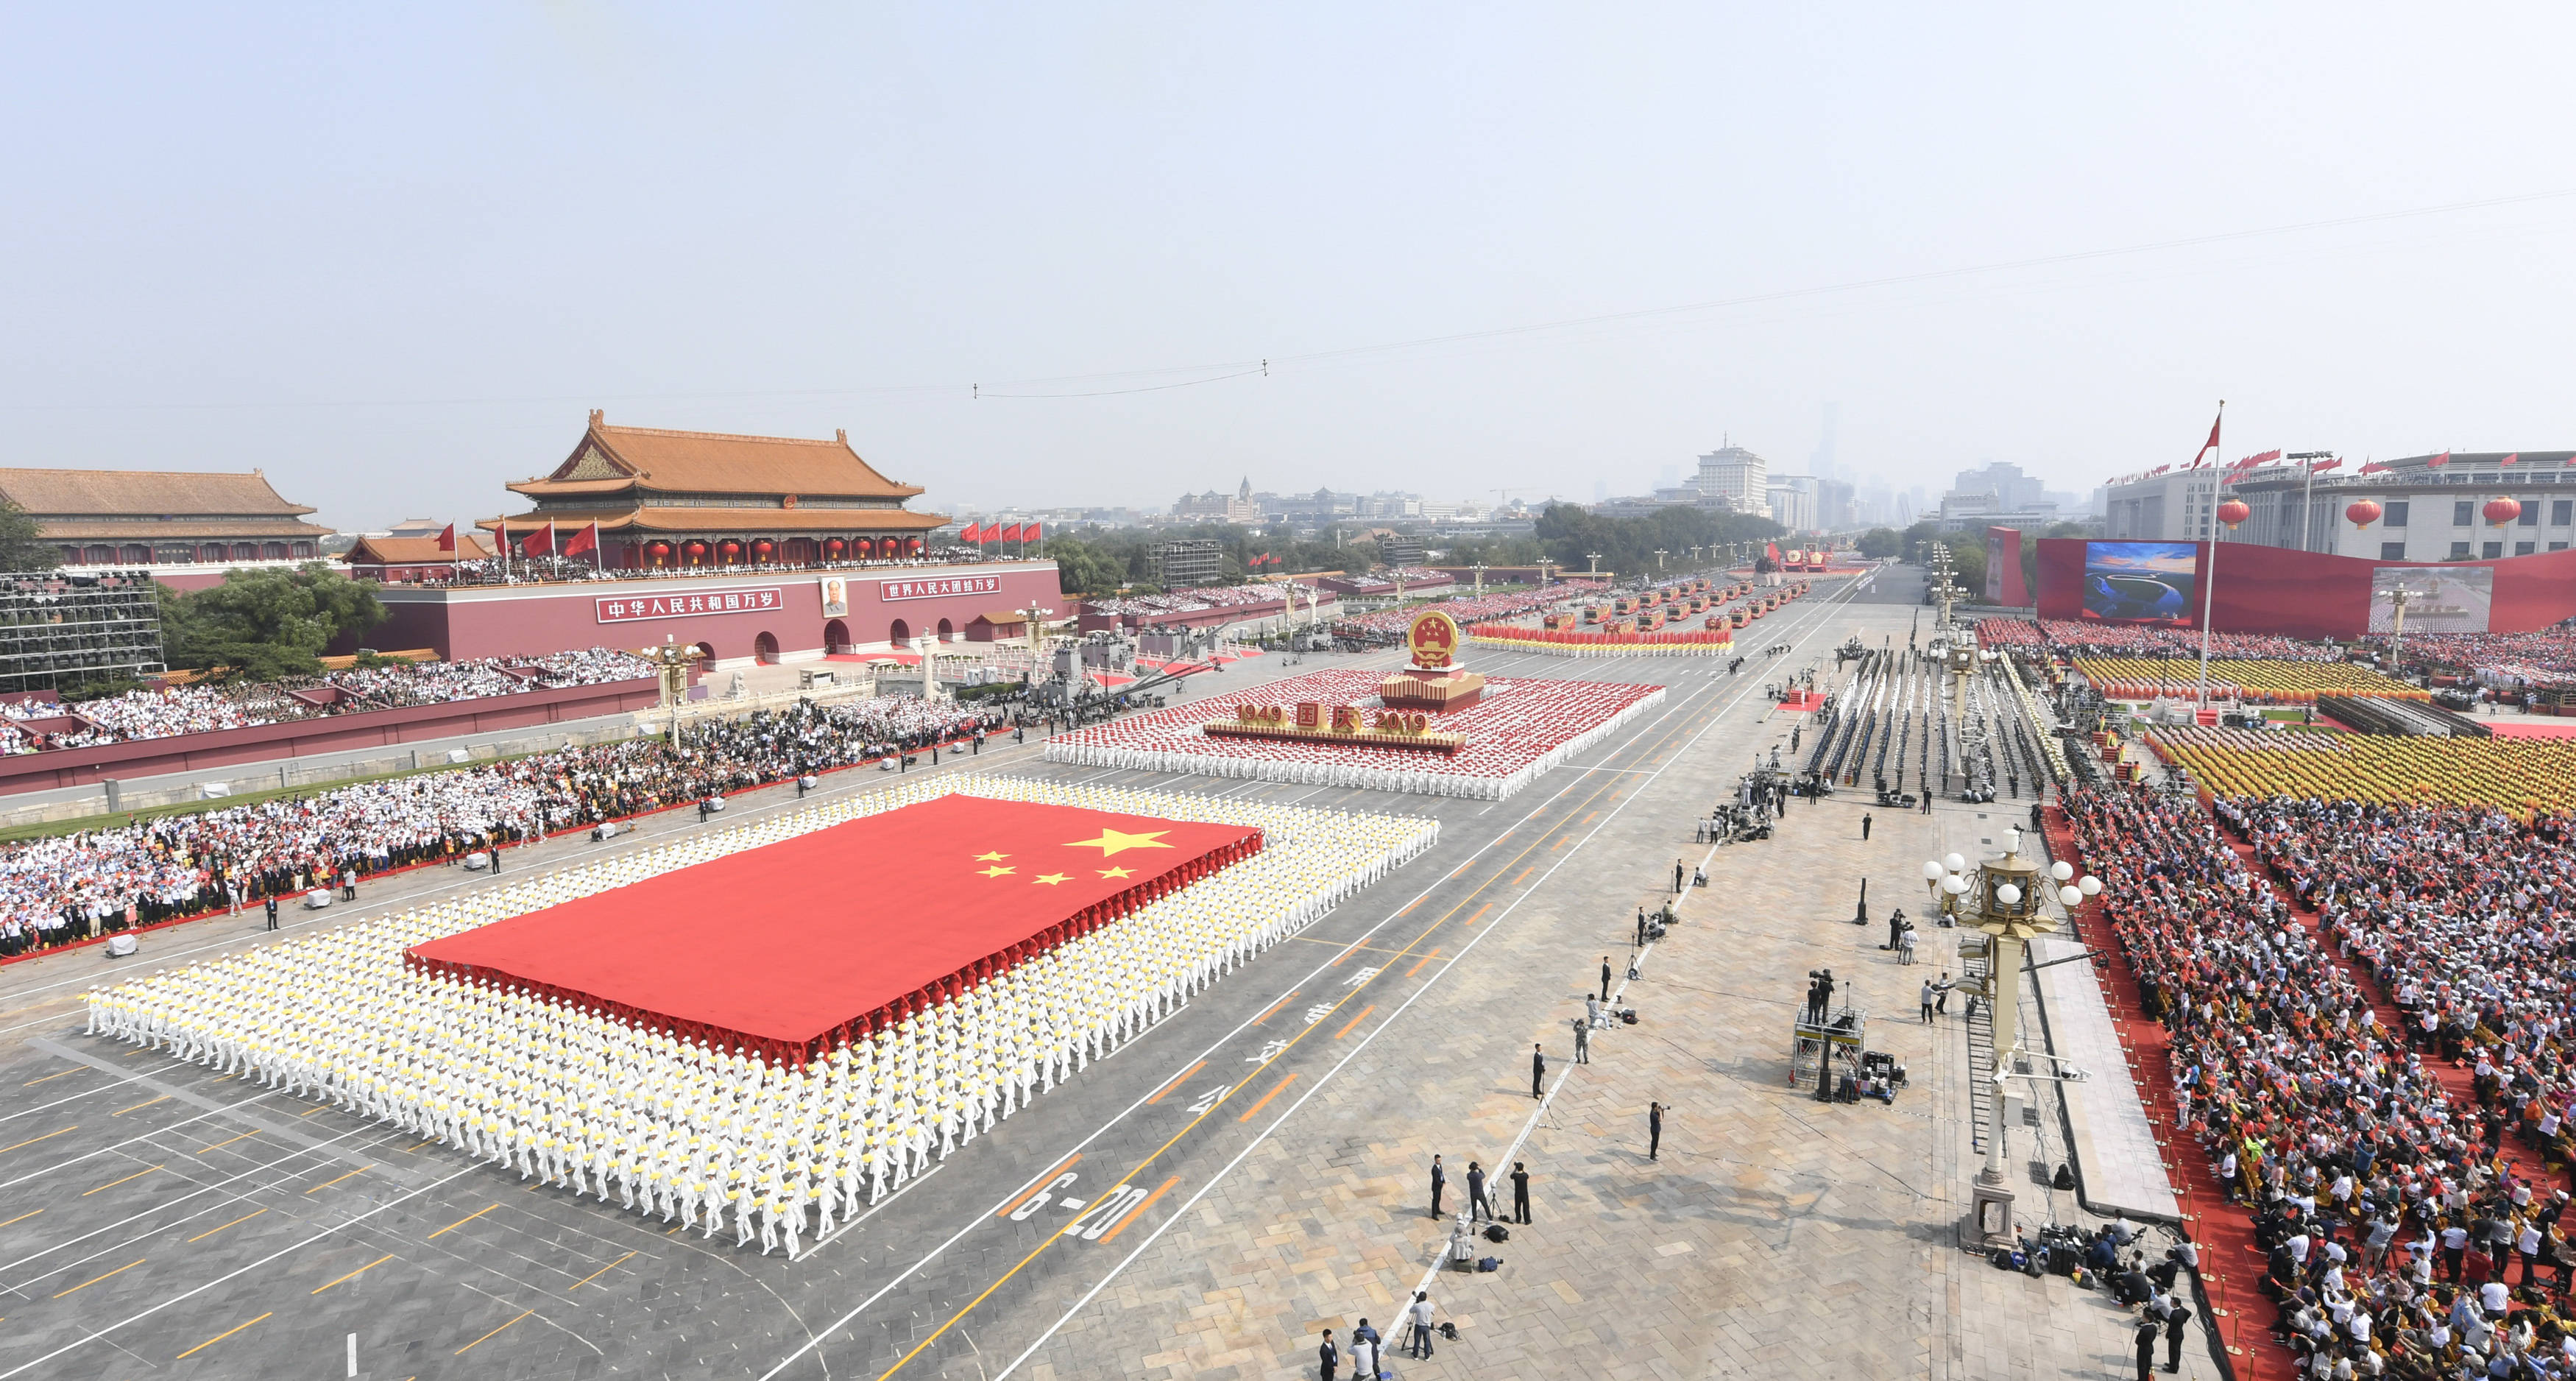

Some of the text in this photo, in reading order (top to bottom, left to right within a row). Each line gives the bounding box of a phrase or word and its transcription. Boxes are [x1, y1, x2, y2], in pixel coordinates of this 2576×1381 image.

[888, 578, 995, 597] 世界人民大团结万岁
[608, 592, 773, 618] 中华人民共和国万岁
[1234, 702, 1426, 731] 1949 国庆 2019
[1010, 1171, 1149, 1240] 6-20
